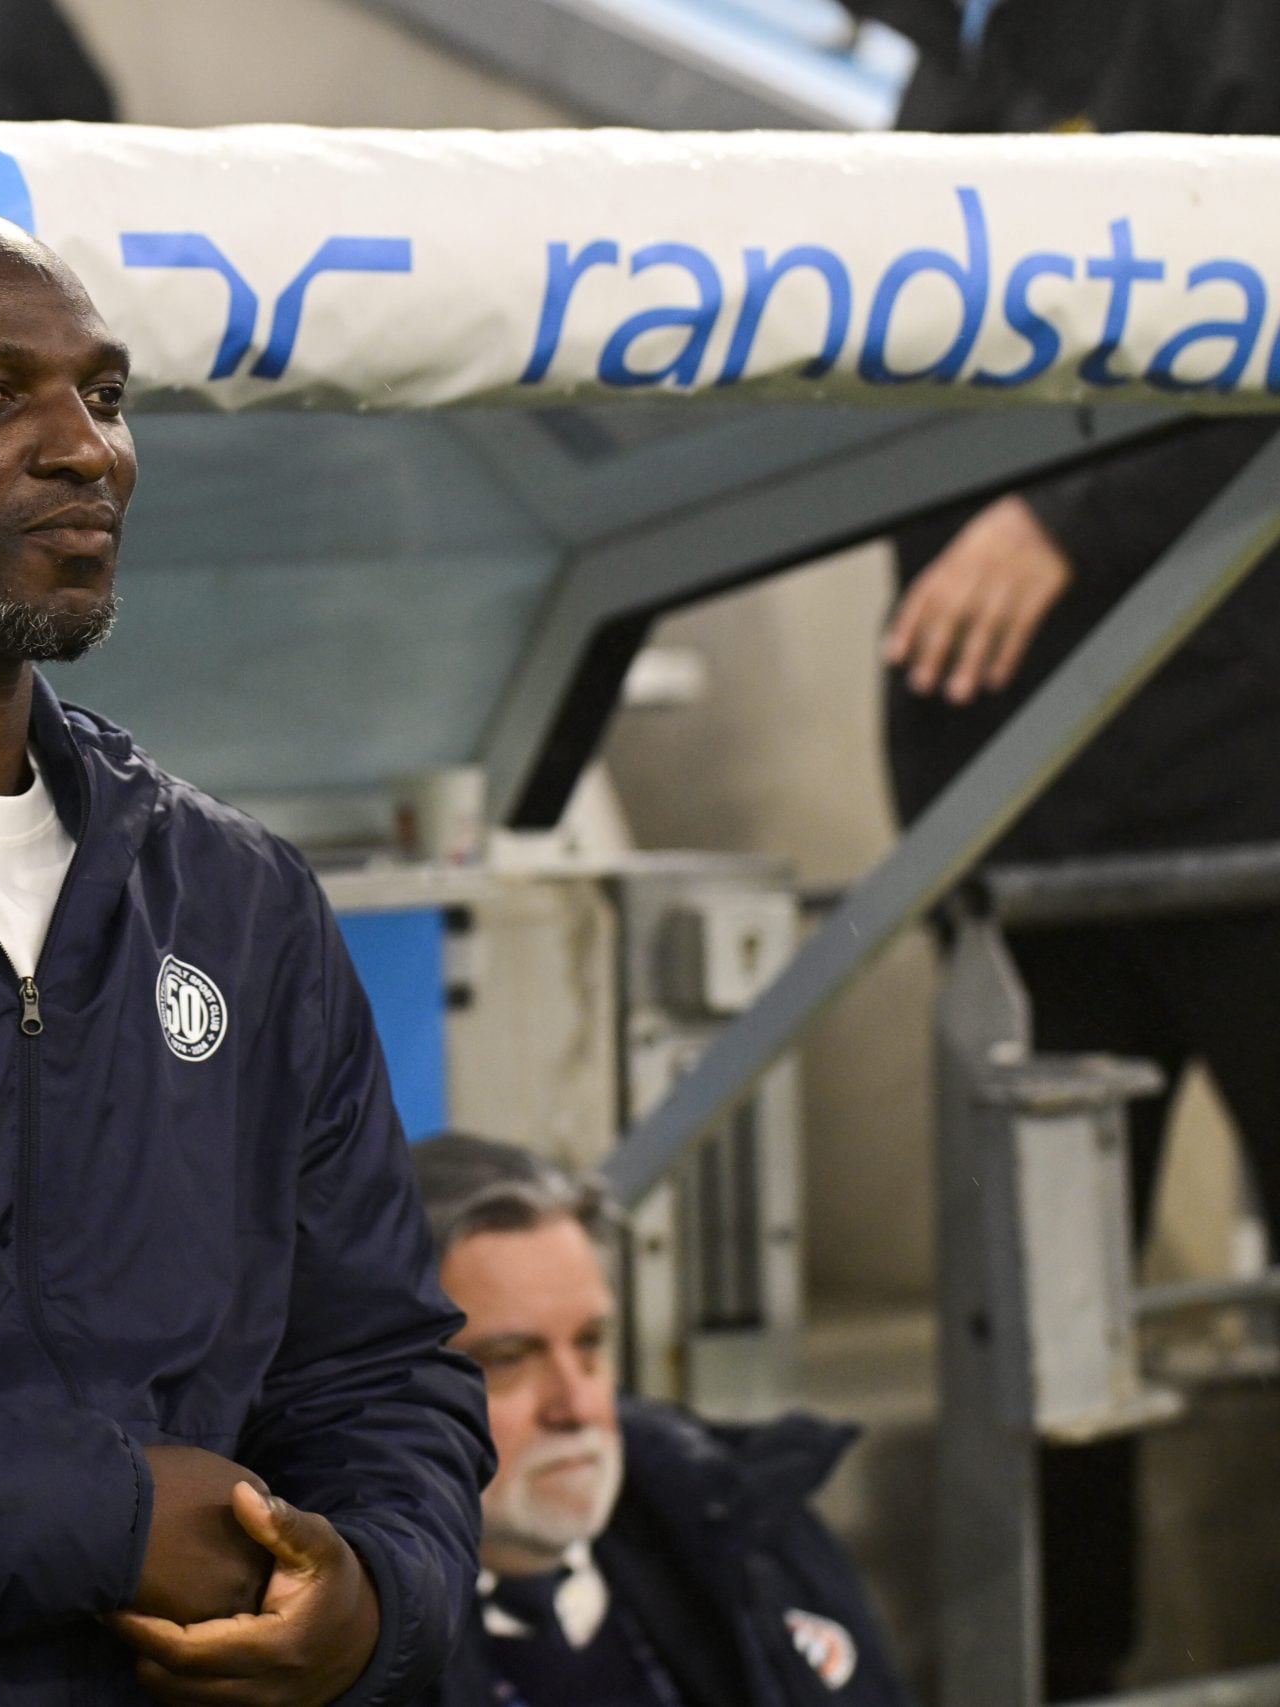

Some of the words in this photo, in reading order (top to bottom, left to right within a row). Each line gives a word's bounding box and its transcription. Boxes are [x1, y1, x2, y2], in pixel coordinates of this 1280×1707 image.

[521, 186, 1280, 394] randsta
[166, 974, 202, 1041] 50
[209, 1004, 221, 1032] CLUB
